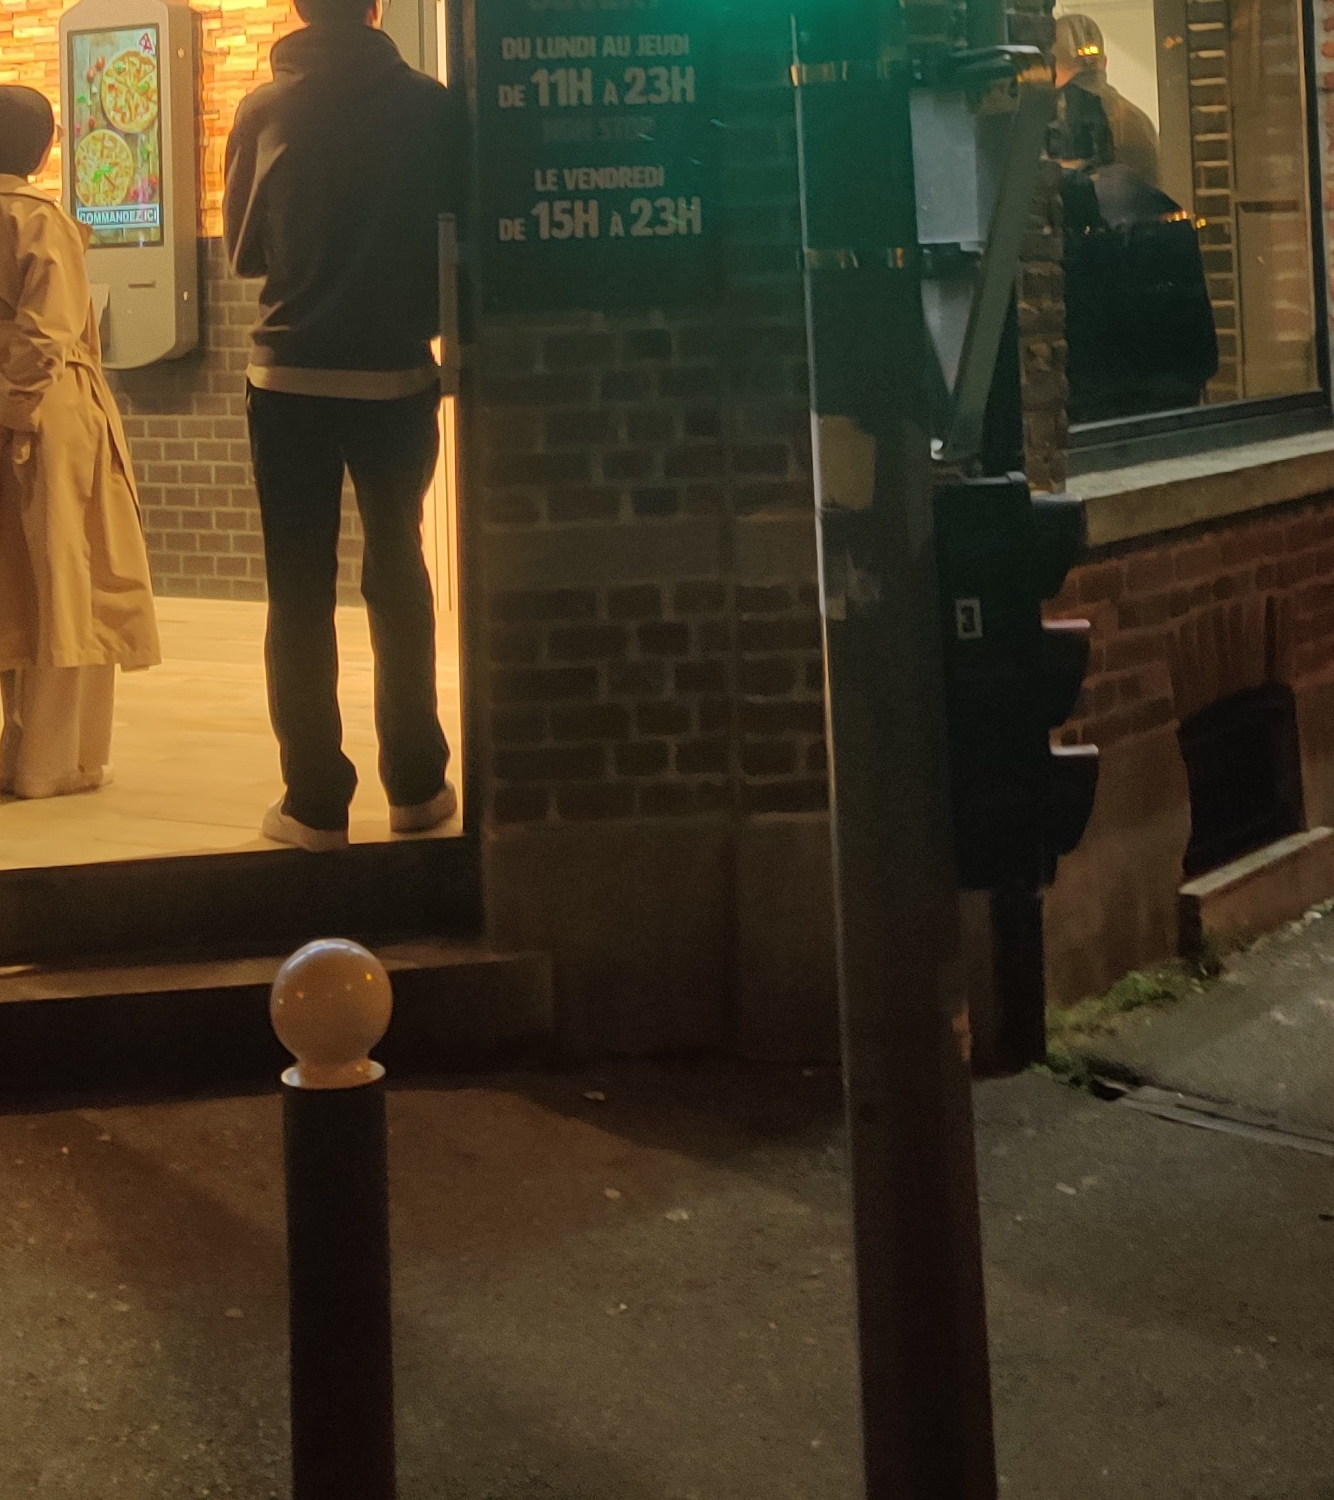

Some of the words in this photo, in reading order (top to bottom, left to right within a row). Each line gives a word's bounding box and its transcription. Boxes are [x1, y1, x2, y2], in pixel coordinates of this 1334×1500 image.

[502, 37, 530, 59] DU
[536, 36, 596, 59] LUNDI
[602, 35, 631, 57] AU
[636, 33, 689, 56] JEUDI
[498, 84, 525, 107] DE
[530, 67, 592, 106] 11H
[623, 65, 695, 104] 23H
[535, 168, 558, 191] LE
[563, 165, 665, 190] VENDREDI
[499, 218, 525, 241] DE
[530, 199, 599, 239] 15H
[629, 196, 702, 236] 23H
[962, 606, 975, 633] 3
